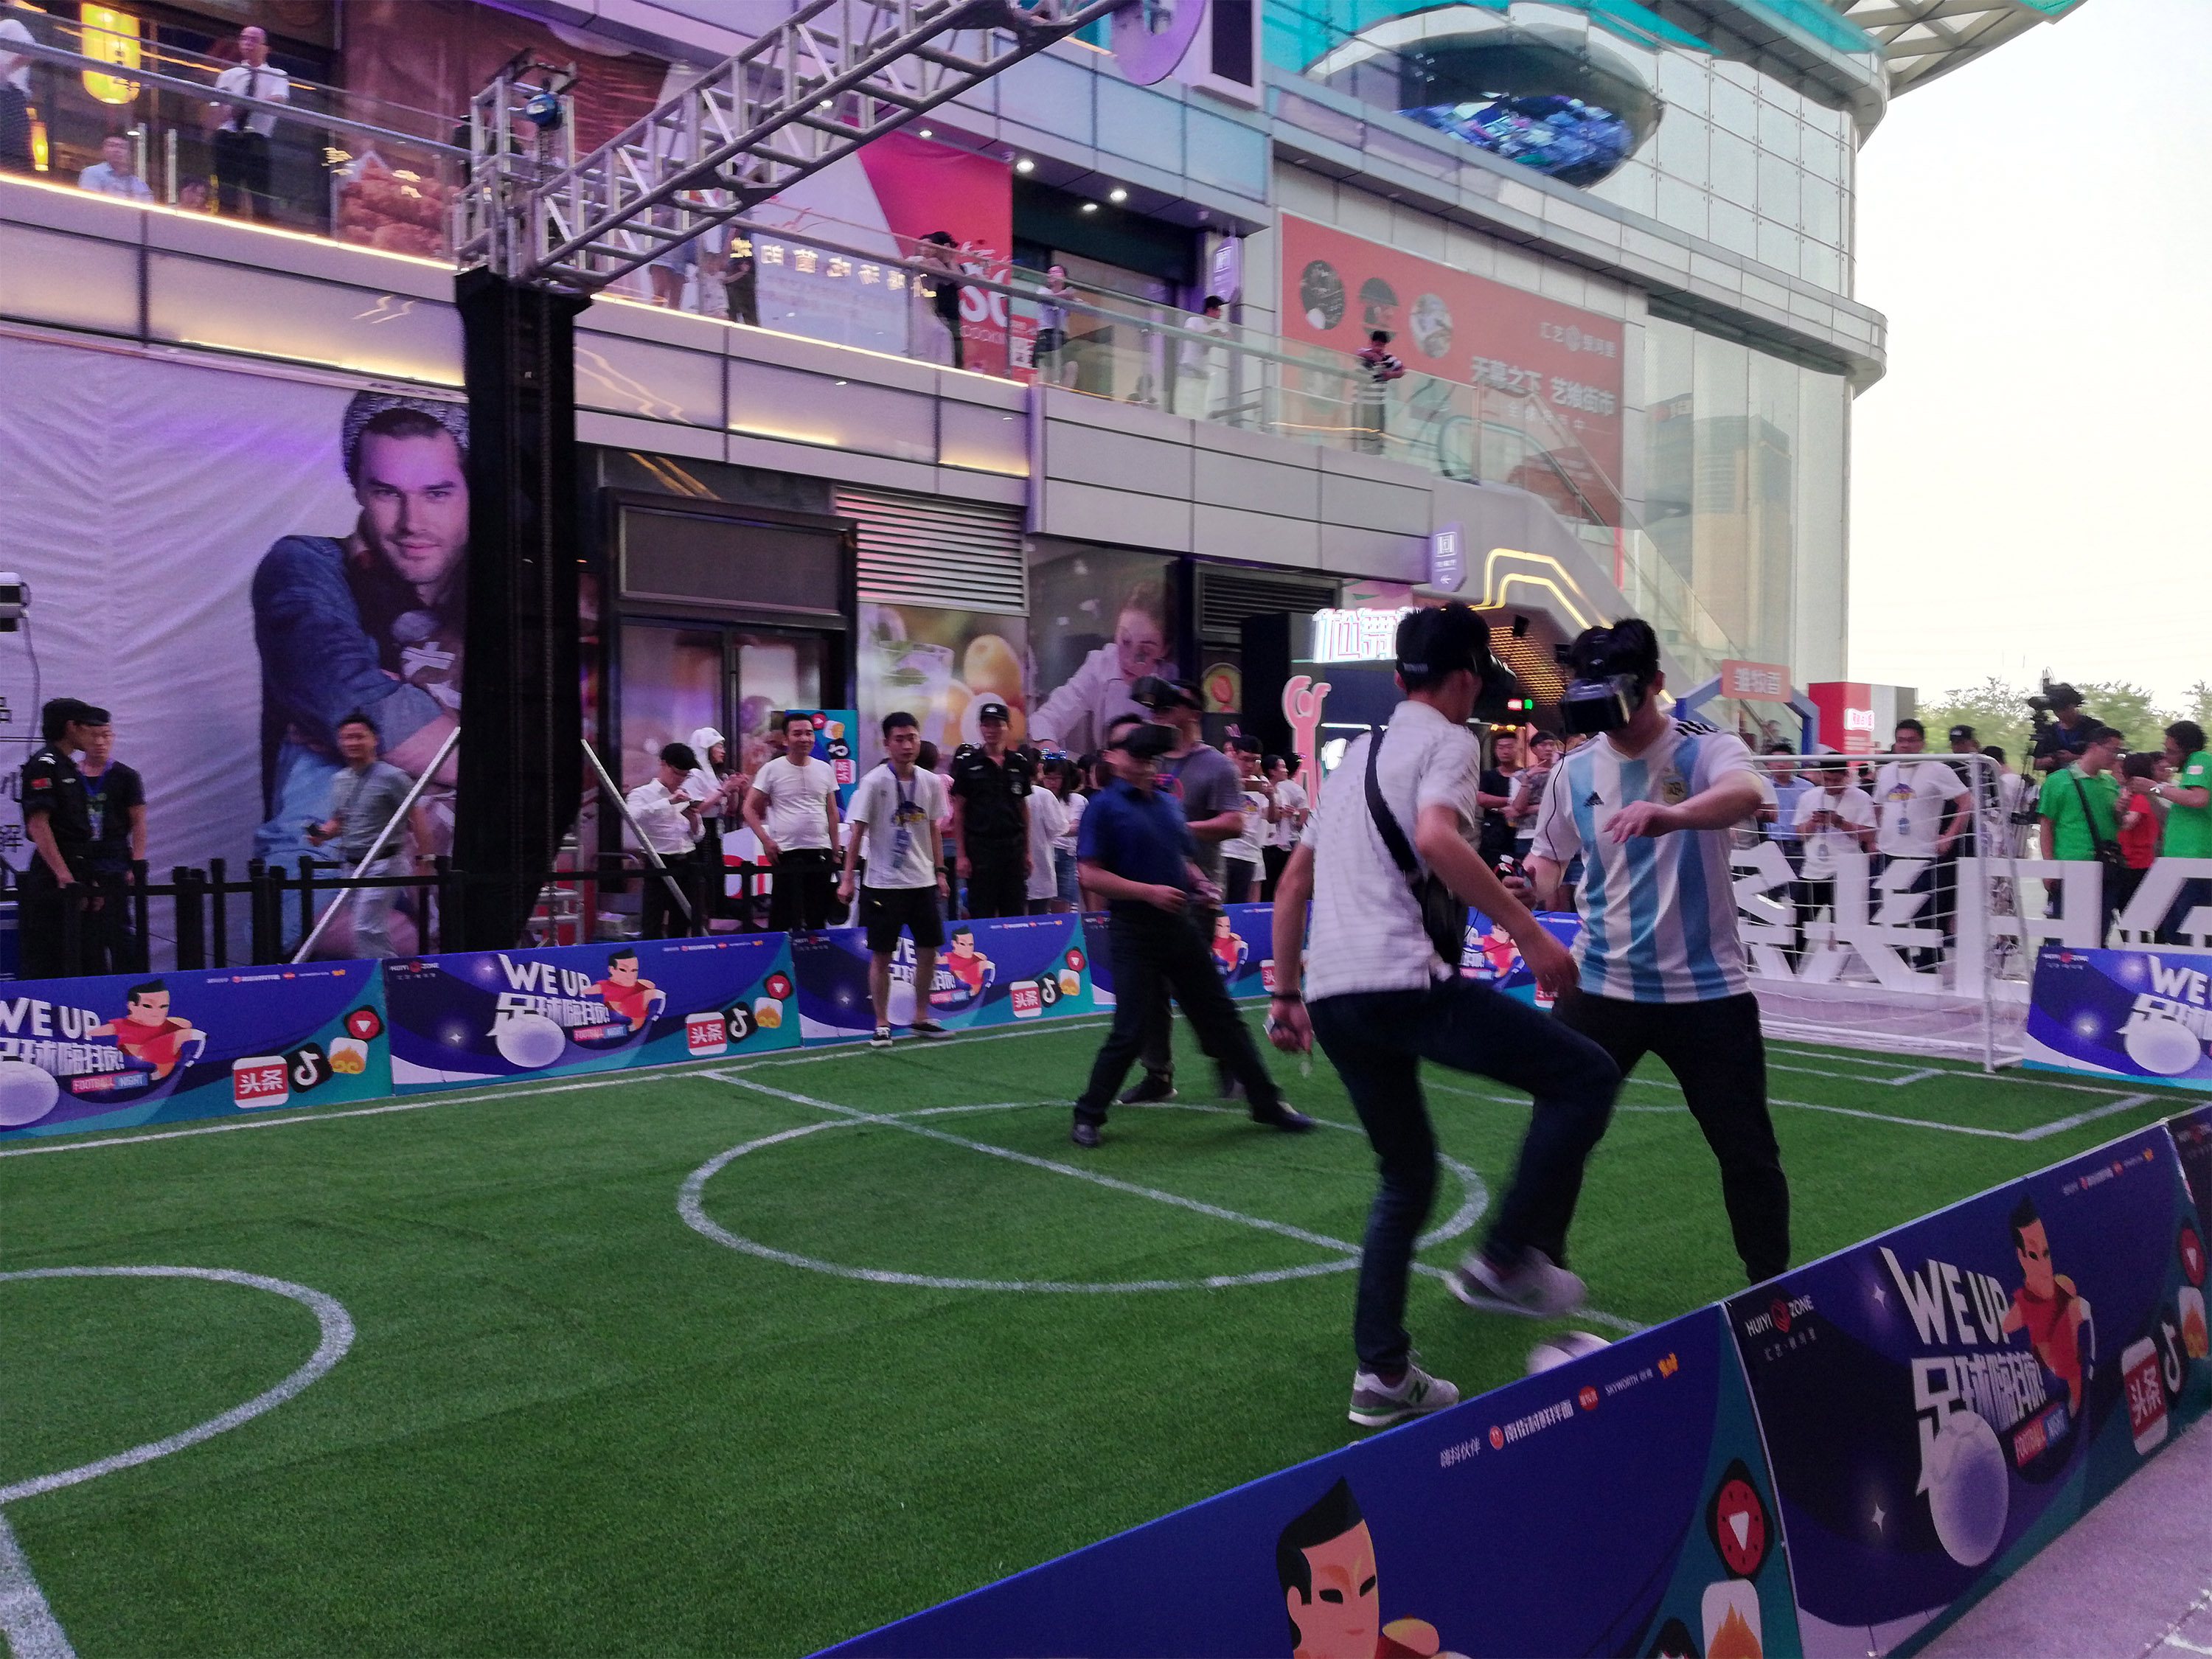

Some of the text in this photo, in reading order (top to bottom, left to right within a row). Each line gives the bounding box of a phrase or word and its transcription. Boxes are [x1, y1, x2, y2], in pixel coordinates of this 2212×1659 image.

[498, 953, 592, 998] WE UP
[2147, 954, 2208, 1005] WE
[1014, 990, 1040, 1009] 头条
[60, 1006, 101, 1042] UP
[690, 1025, 724, 1046] 头条
[74, 1077, 114, 1092] FOOTBALL
[239, 1068, 284, 1094] 头条
[1878, 1246, 2012, 1345] WE UP
[1744, 1294, 1815, 1338] HUIYI ZONE
[2129, 1367, 2164, 1426] 头条
